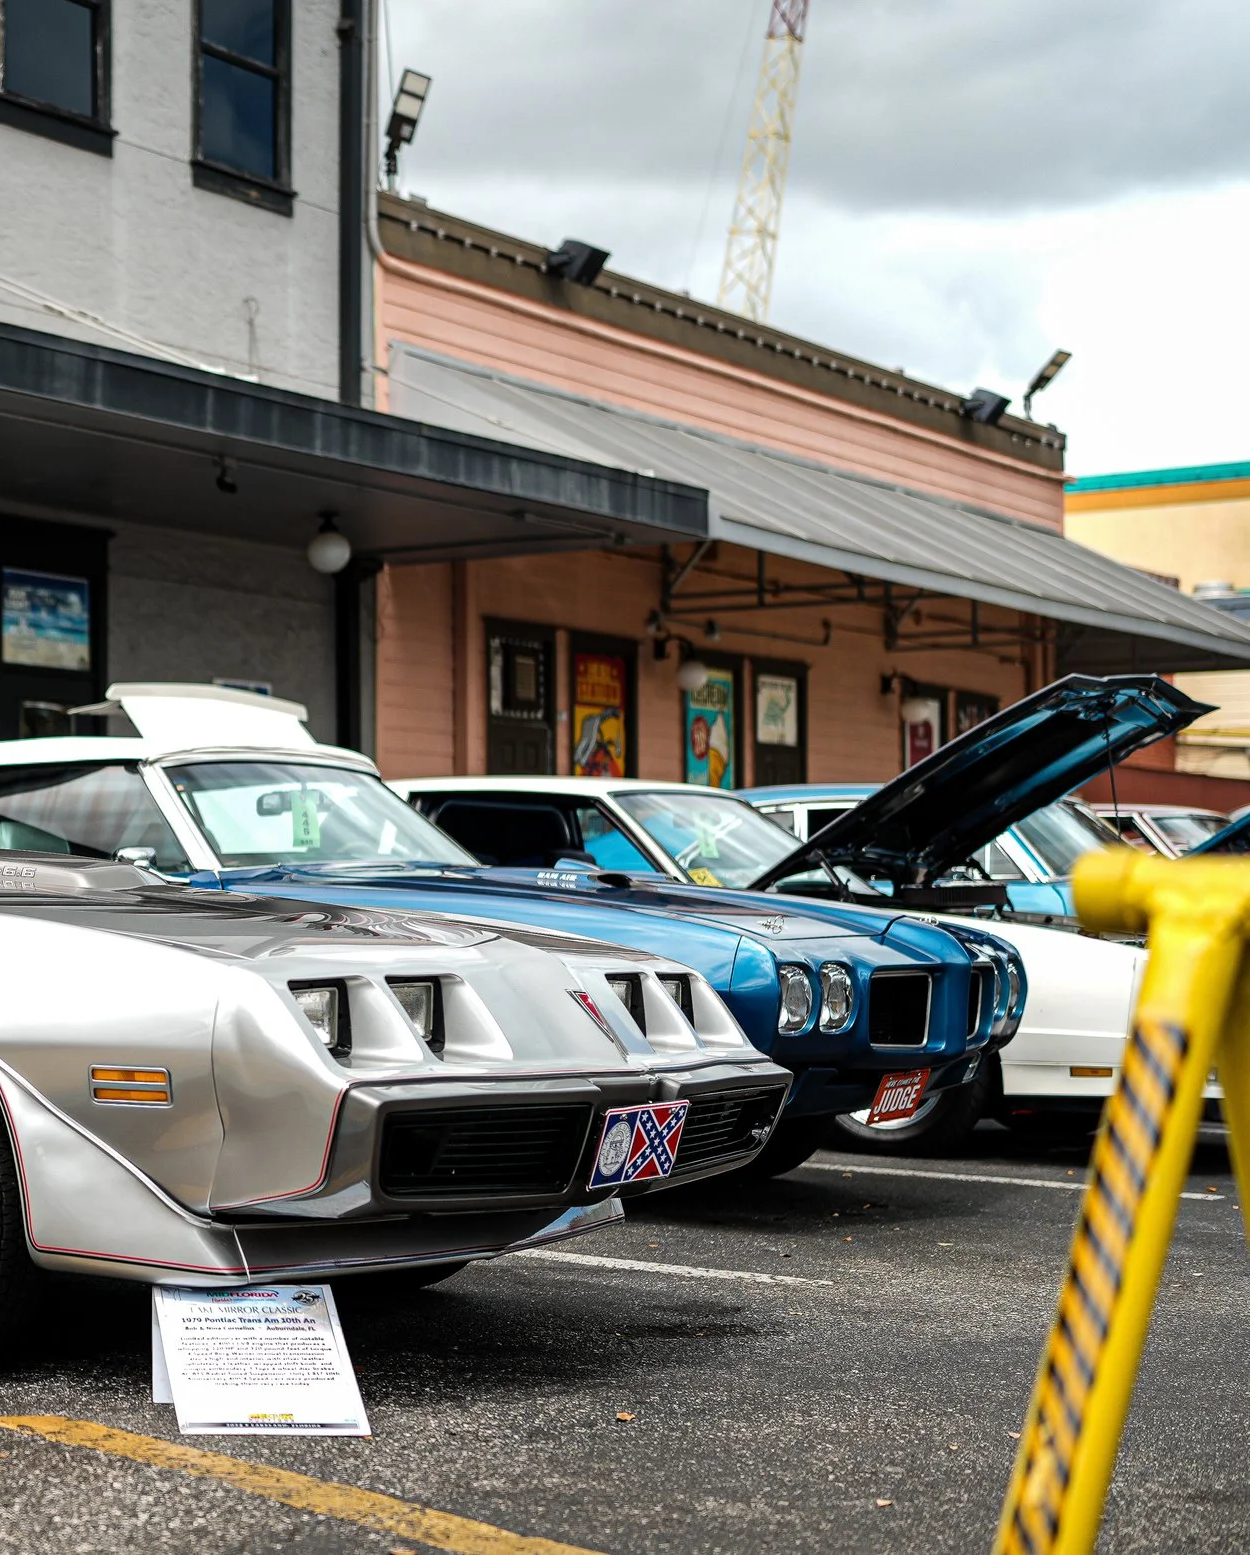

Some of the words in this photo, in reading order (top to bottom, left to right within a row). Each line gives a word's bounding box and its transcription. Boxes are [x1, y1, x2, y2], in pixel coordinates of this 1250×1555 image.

[537, 872, 558, 880] RAM
[559, 873, 578, 881] AIR
[873, 1084, 921, 1114] JUDGE
[262, 1306, 302, 1314] CLASSIC
[303, 1317, 316, 1325] An
